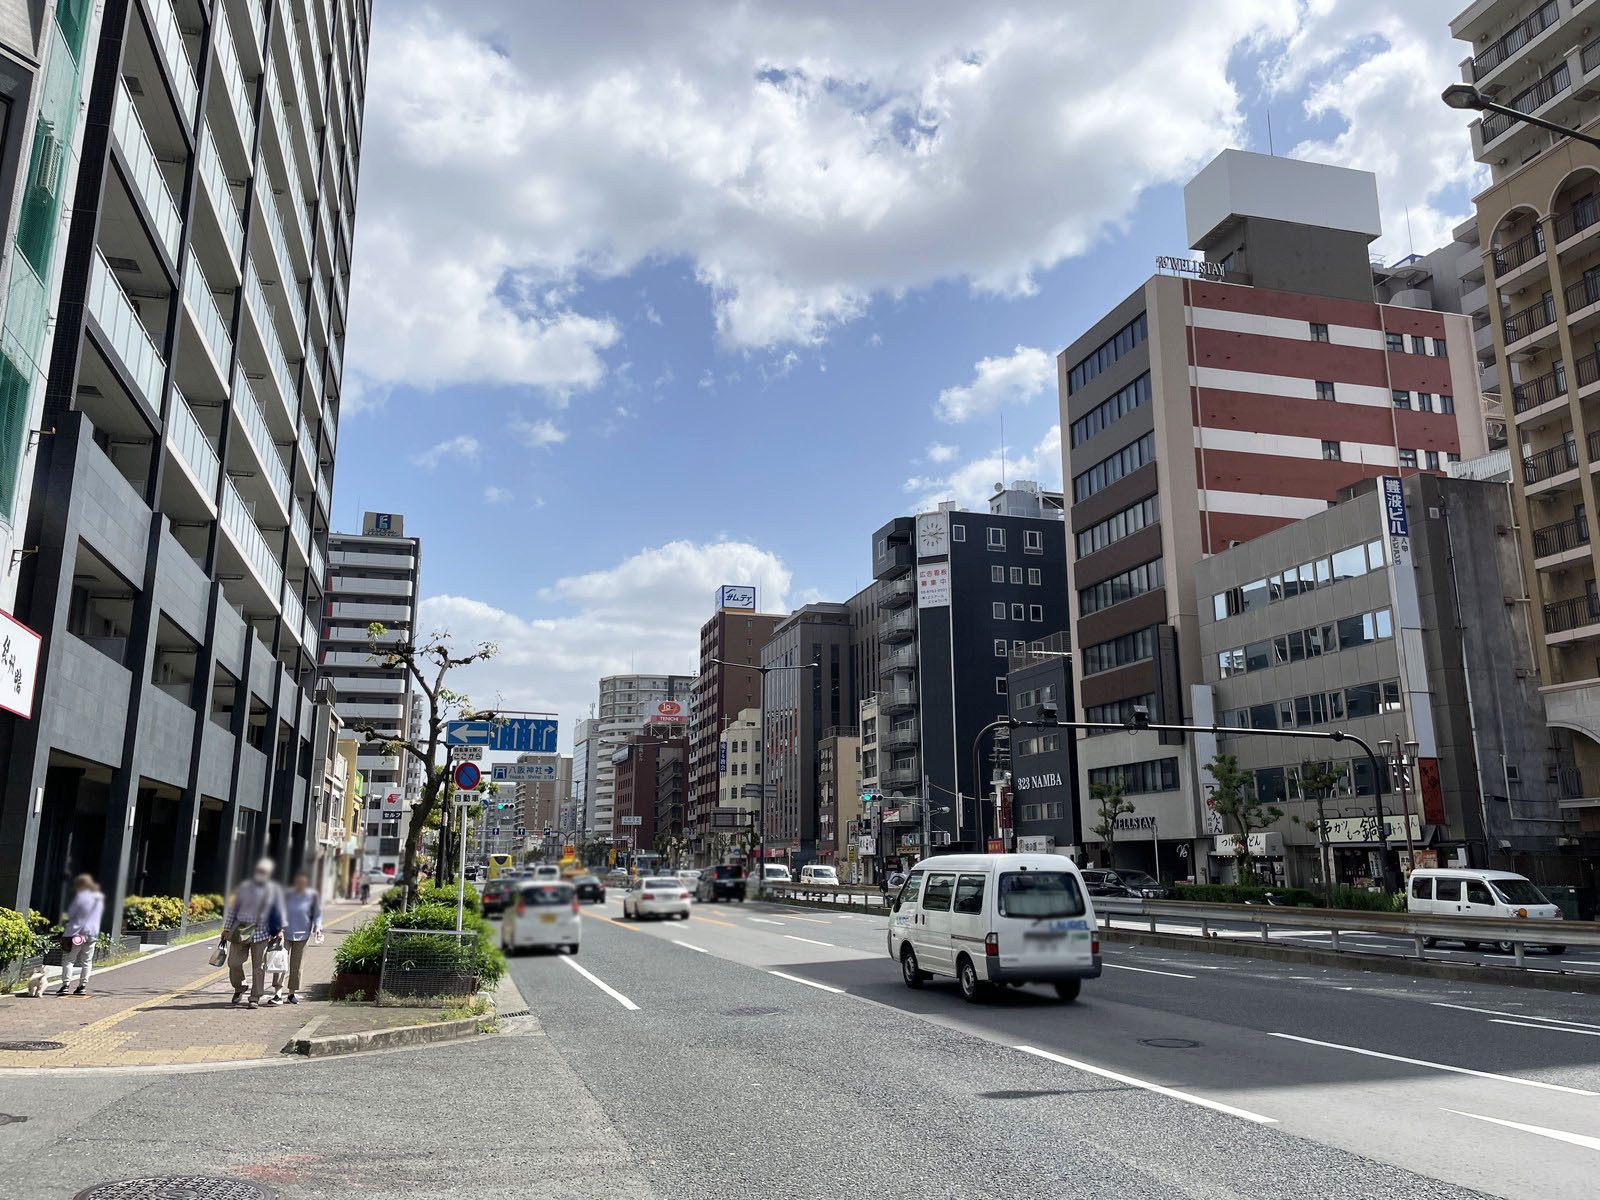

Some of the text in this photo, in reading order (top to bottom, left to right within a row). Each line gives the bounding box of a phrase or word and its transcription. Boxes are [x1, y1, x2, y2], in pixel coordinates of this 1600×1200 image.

[1385, 479, 1406, 534] 難波ビル
[509, 766, 543, 775] 八阪神社
[1017, 773, 1063, 791] 323 NAMBA
[454, 794, 479, 803] 自動車
